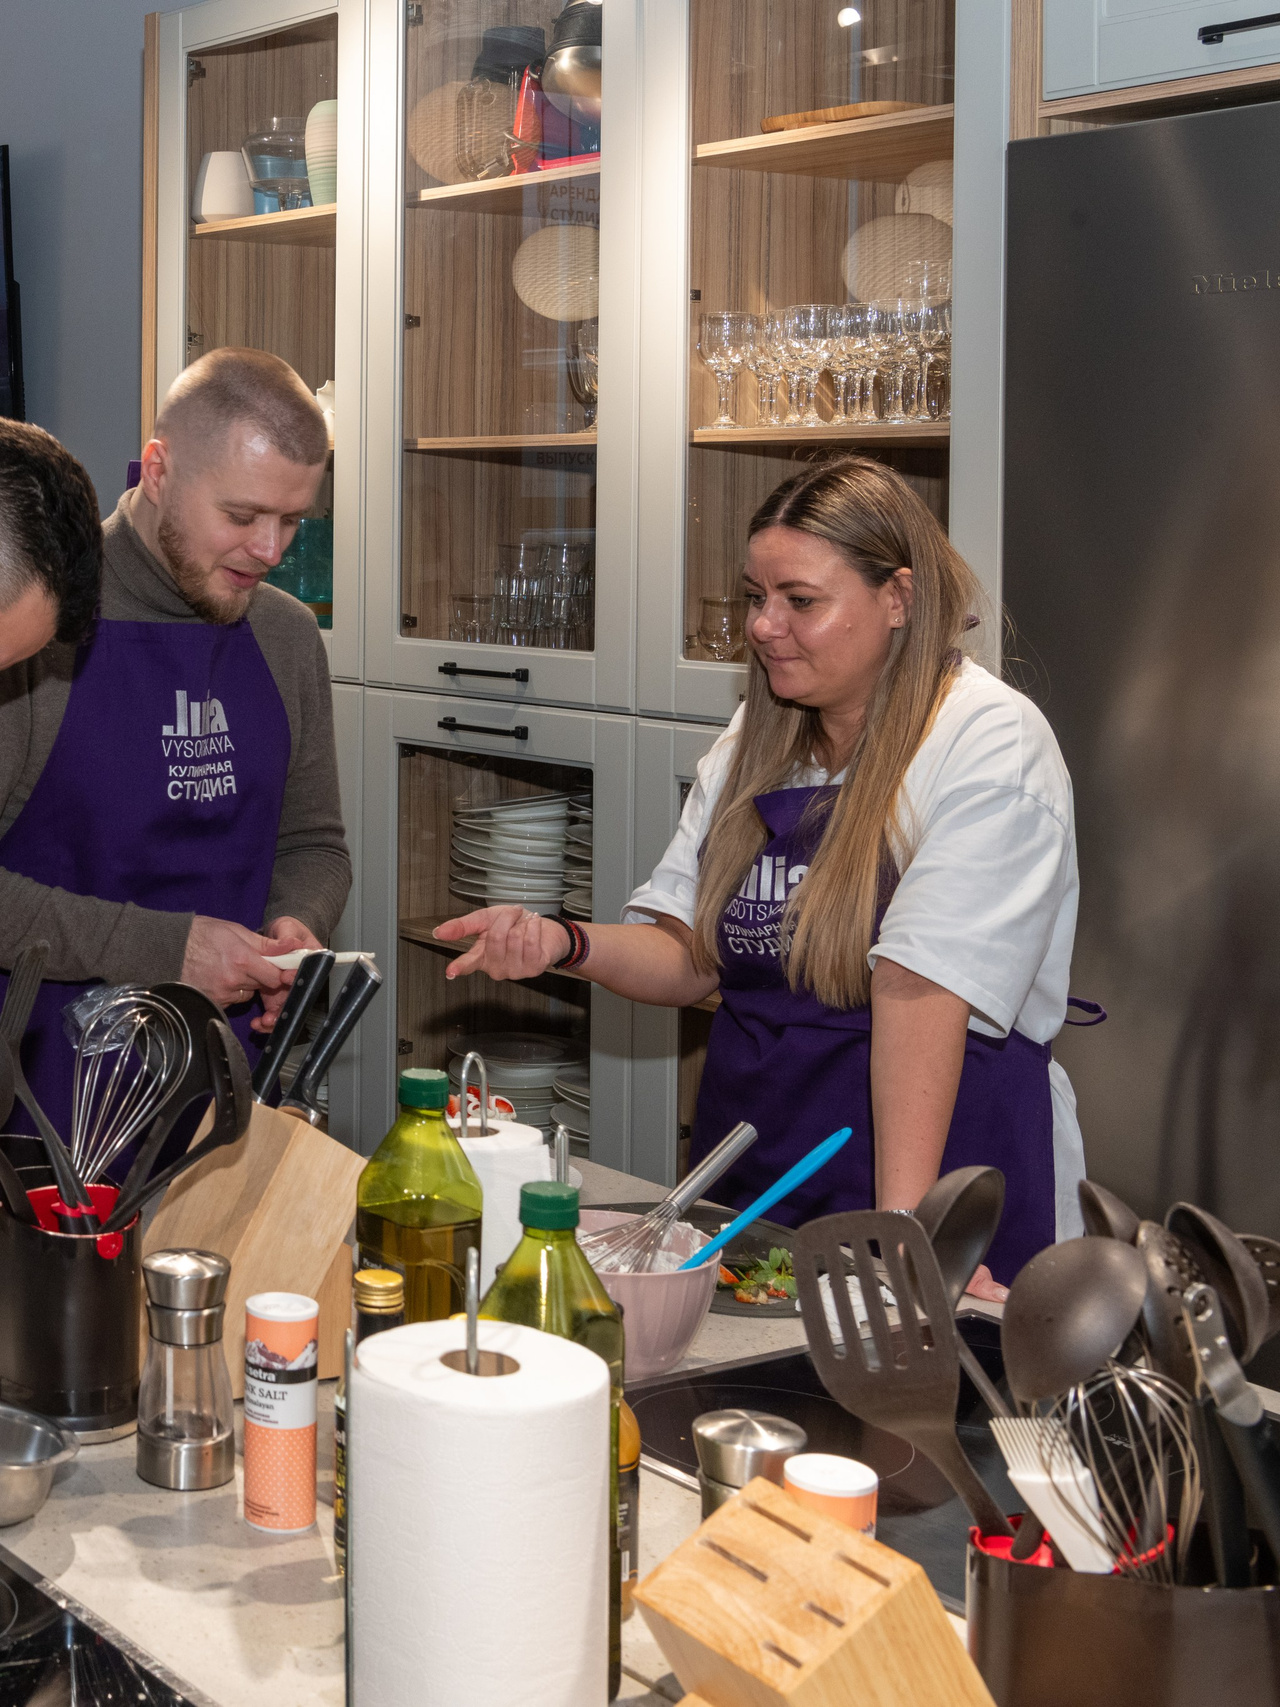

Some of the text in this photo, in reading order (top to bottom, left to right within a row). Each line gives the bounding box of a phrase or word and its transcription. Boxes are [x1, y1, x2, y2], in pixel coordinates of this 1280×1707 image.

[550, 184, 600, 203] АРЕНД
[162, 689, 229, 737] Jua
[167, 775, 237, 803] СТУДИЯ
[723, 920, 798, 939] КУЛИНАРН
[728, 935, 794, 957] СТУДИ
[258, 1387, 288, 1401] SALT
